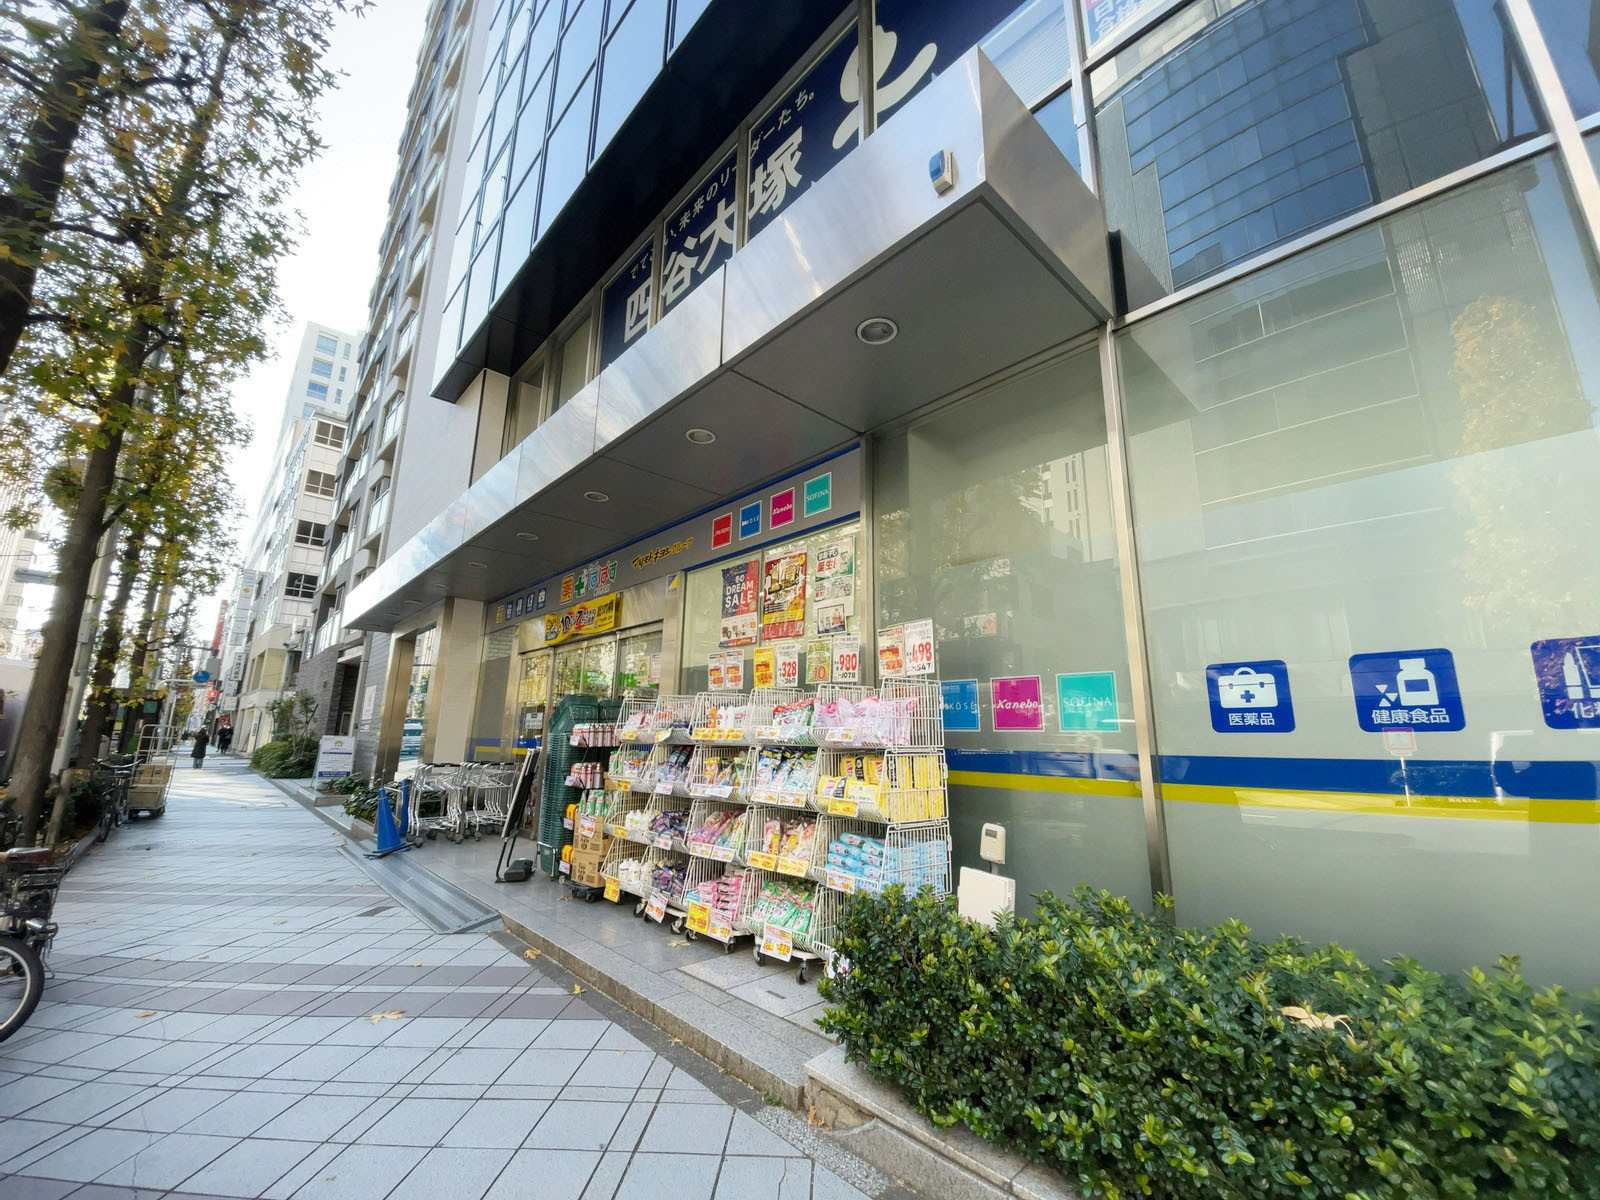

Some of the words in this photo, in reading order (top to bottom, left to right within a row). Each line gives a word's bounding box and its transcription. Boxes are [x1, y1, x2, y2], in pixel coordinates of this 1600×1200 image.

[623, 125, 803, 344] 四谷大塚
[806, 488, 830, 502] SOFINA
[772, 503, 793, 516] Kanebo
[726, 580, 754, 596] DREAM
[725, 590, 753, 608] SALE
[781, 661, 797, 677] 328
[839, 653, 857, 671] 980
[996, 698, 1039, 710] Kanebo
[1063, 696, 1113, 708] SOFINA
[1228, 712, 1276, 726] 医薬品
[1371, 707, 1450, 725] 健康食品
